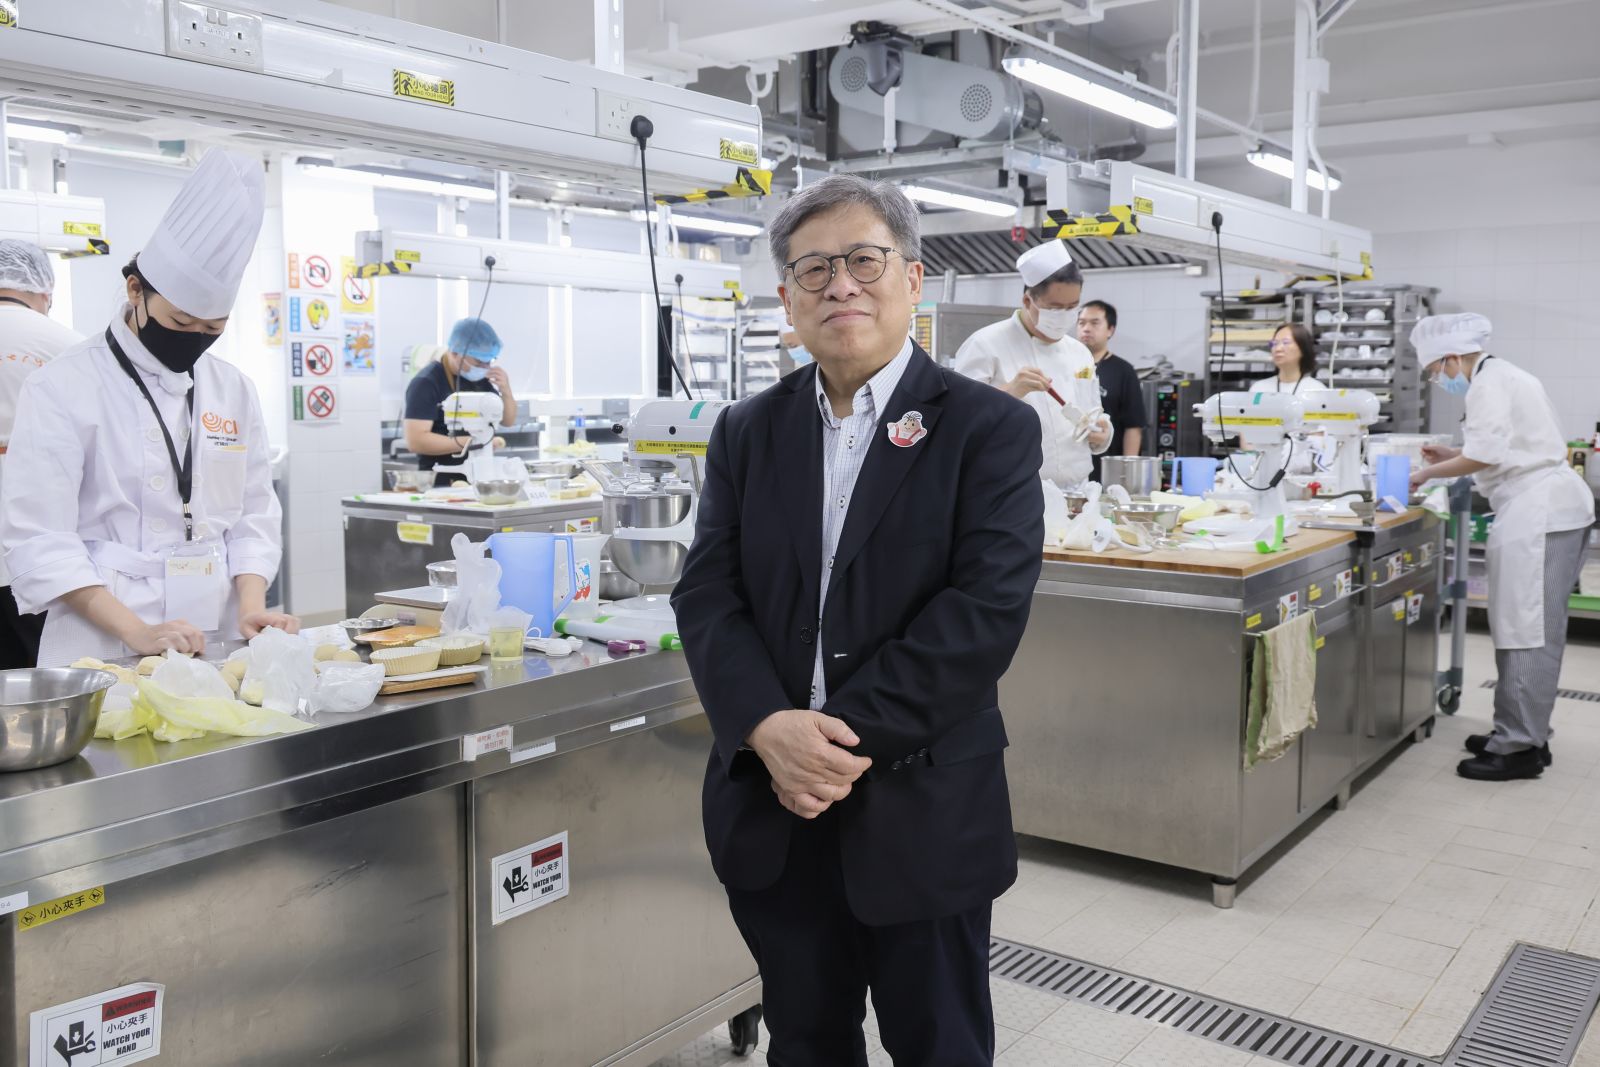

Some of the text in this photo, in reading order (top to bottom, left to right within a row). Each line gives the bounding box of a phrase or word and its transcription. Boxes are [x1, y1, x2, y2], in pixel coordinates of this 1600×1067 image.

[535, 860, 559, 877] 小心夾手
[532, 873, 562, 889] WATCH YOUR
[541, 884, 554, 894] HAND
[39, 894, 86, 919] 小心夾手
[106, 1012, 148, 1034] 小心夾手
[103, 1027, 151, 1049] WATCH YOUR
[116, 1042, 137, 1055] HAND
